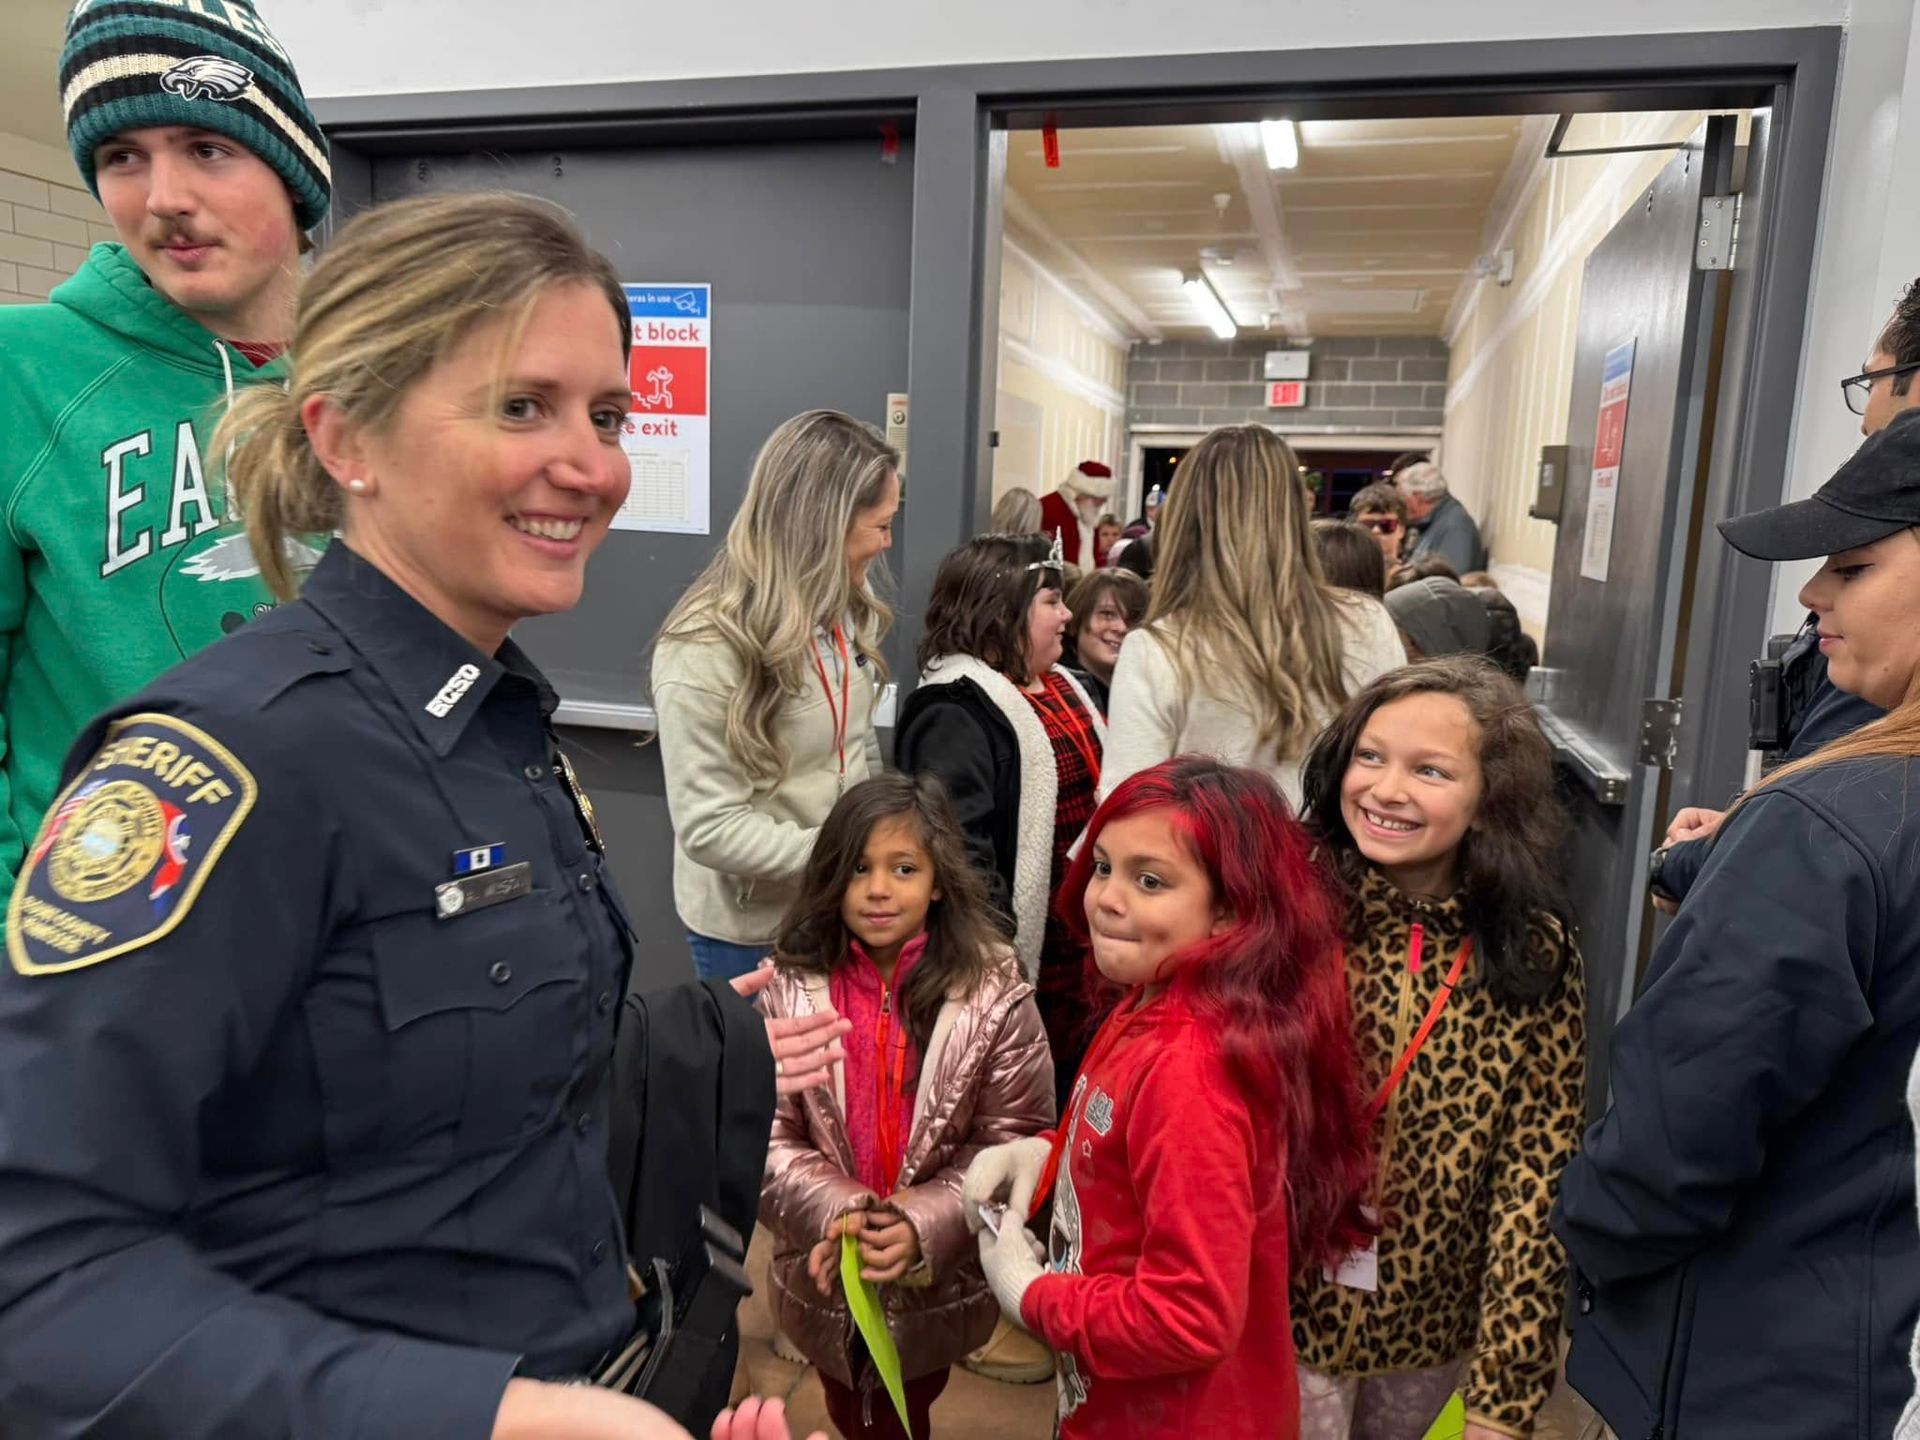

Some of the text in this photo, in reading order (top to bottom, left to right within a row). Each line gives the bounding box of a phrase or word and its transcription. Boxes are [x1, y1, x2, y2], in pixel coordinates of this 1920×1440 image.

[647, 293, 656, 303] in
[648, 322, 699, 341] block
[641, 419, 678, 436] exit
